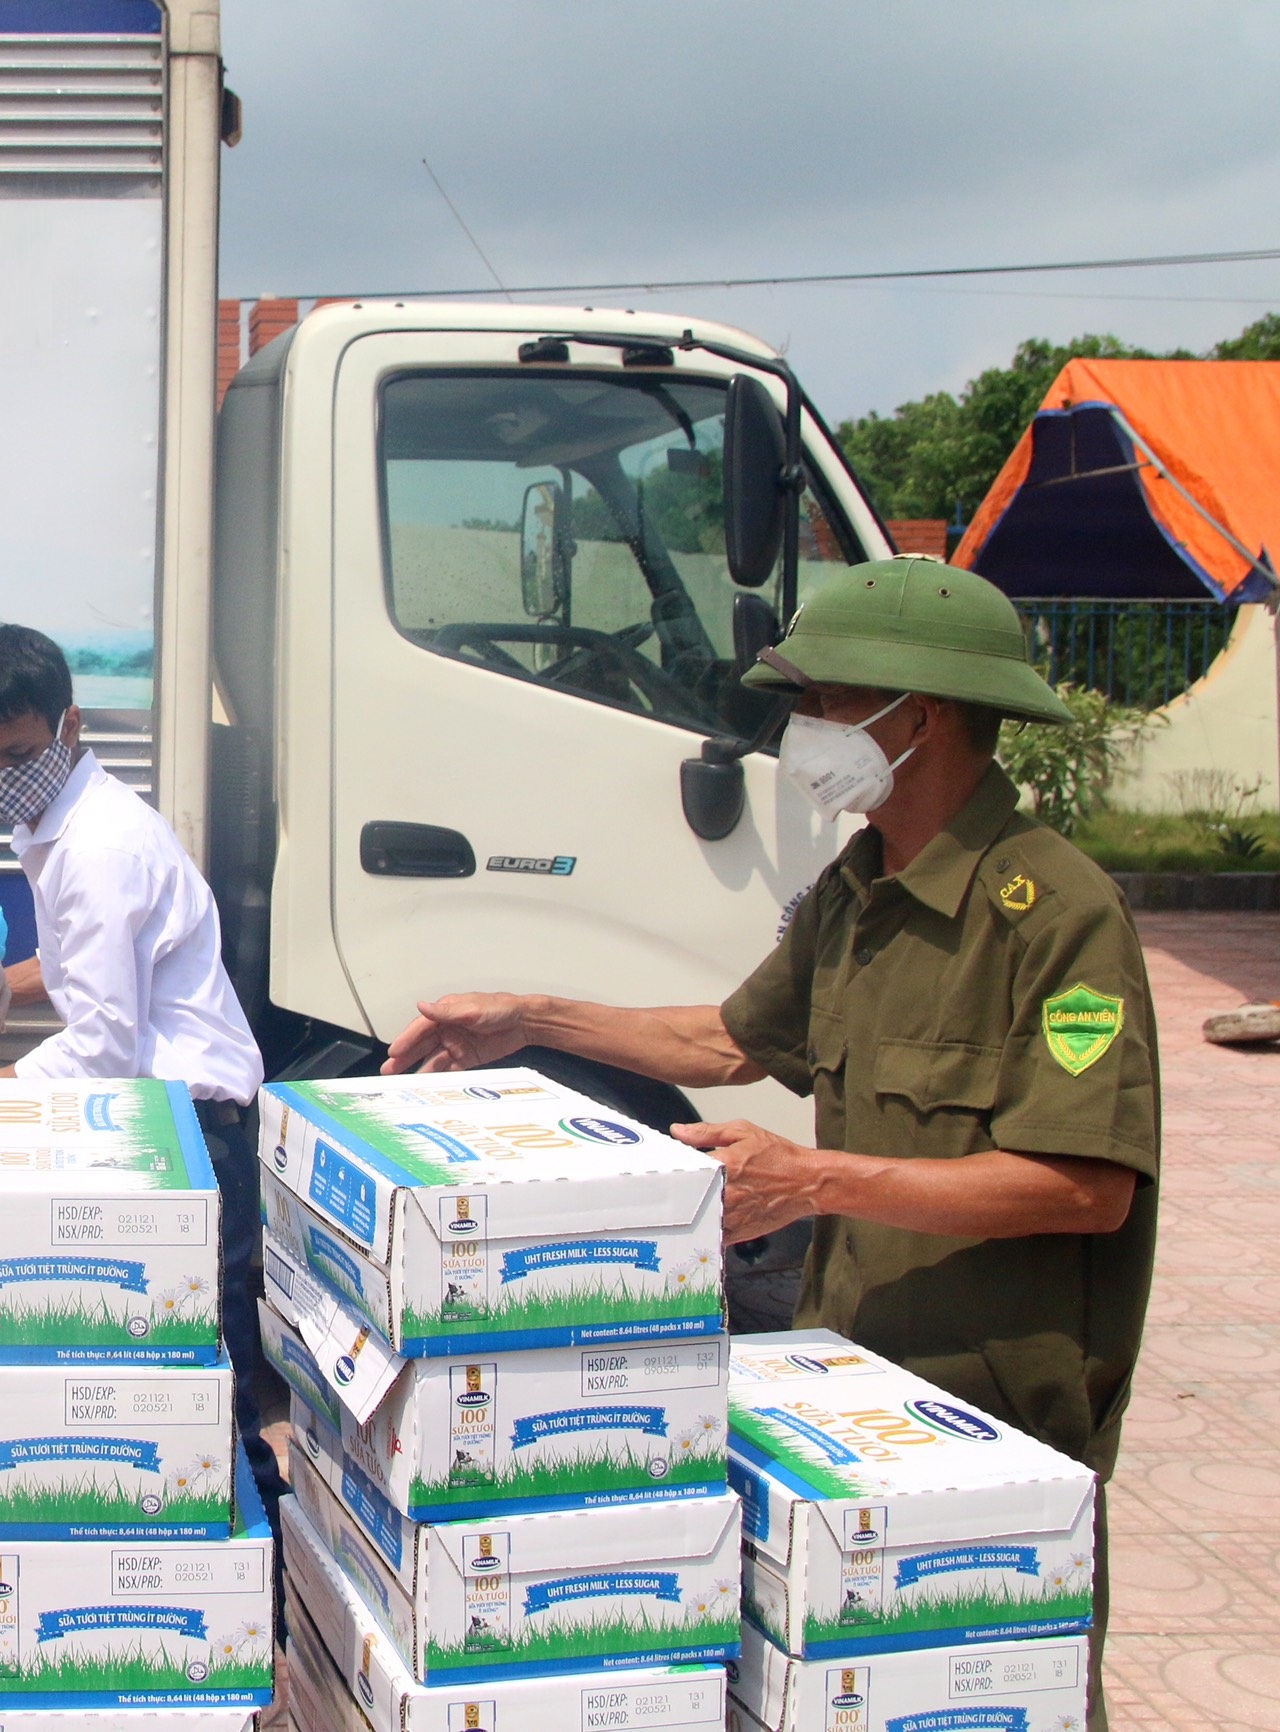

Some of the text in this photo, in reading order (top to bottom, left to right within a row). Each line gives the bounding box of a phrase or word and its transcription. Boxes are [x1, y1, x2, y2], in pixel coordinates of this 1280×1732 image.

[1049, 1008, 1115, 1022] CÔNG AN VIÊN
[576, 1119, 635, 1144] VINAMILK
[58, 1207, 103, 1221] HSD/EXP:
[118, 1214, 195, 1224] 021121 T31
[58, 1226, 104, 1240] NSX/PRD:
[118, 1224, 190, 1234] 020521 18
[524, 1247, 638, 1265] UHT FRESH MILK LESS SUGAR
[15, 1264, 36, 1275] TƯƠI
[38, 1263, 55, 1275] TIỆT
[57, 1262, 86, 1274] TRÙNG
[87, 1264, 95, 1274] ÍT
[97, 1265, 129, 1278] ĐƯỜNG
[581, 1330, 592, 1338] Net
[593, 1329, 618, 1337] content:
[619, 1327, 632, 1335] 8.64
[633, 1325, 648, 1334] litres
[650, 1325, 659, 1333] (48
[660, 1323, 676, 1333] packs
[694, 1320, 704, 1329] ml)
[587, 1356, 628, 1372] HSD/EXP:
[644, 1352, 714, 1366] 091121 T32
[644, 1362, 707, 1375] 090521 01
[588, 1374, 628, 1390] NSX/PRD:
[920, 1401, 995, 1440] VINAMILK
[784, 1401, 903, 1462] SỮA TƯƠI
[850, 1532, 879, 1541] VINAMILK
[118, 1558, 162, 1571] HSD/EXP:
[175, 1562, 250, 1572] 021121 T31
[471, 1557, 500, 1568] VINAMILK
[917, 1553, 1020, 1571] UHT FRESH MILK LESS SUGAR
[118, 1576, 163, 1589] NSX/PRD:
[174, 1572, 246, 1582] 020521 18
[59, 1611, 187, 1626] SỮA TƯƠI TIỆT TRÙNG ÍT ĐƯỜNG
[955, 1660, 992, 1675] HSD/EXP:
[1004, 1660, 1067, 1673] 021121 T31
[1004, 1669, 1063, 1682] 020521 18
[955, 1677, 993, 1693] NSX/PRD:
[832, 1694, 863, 1705] VINAMILK
